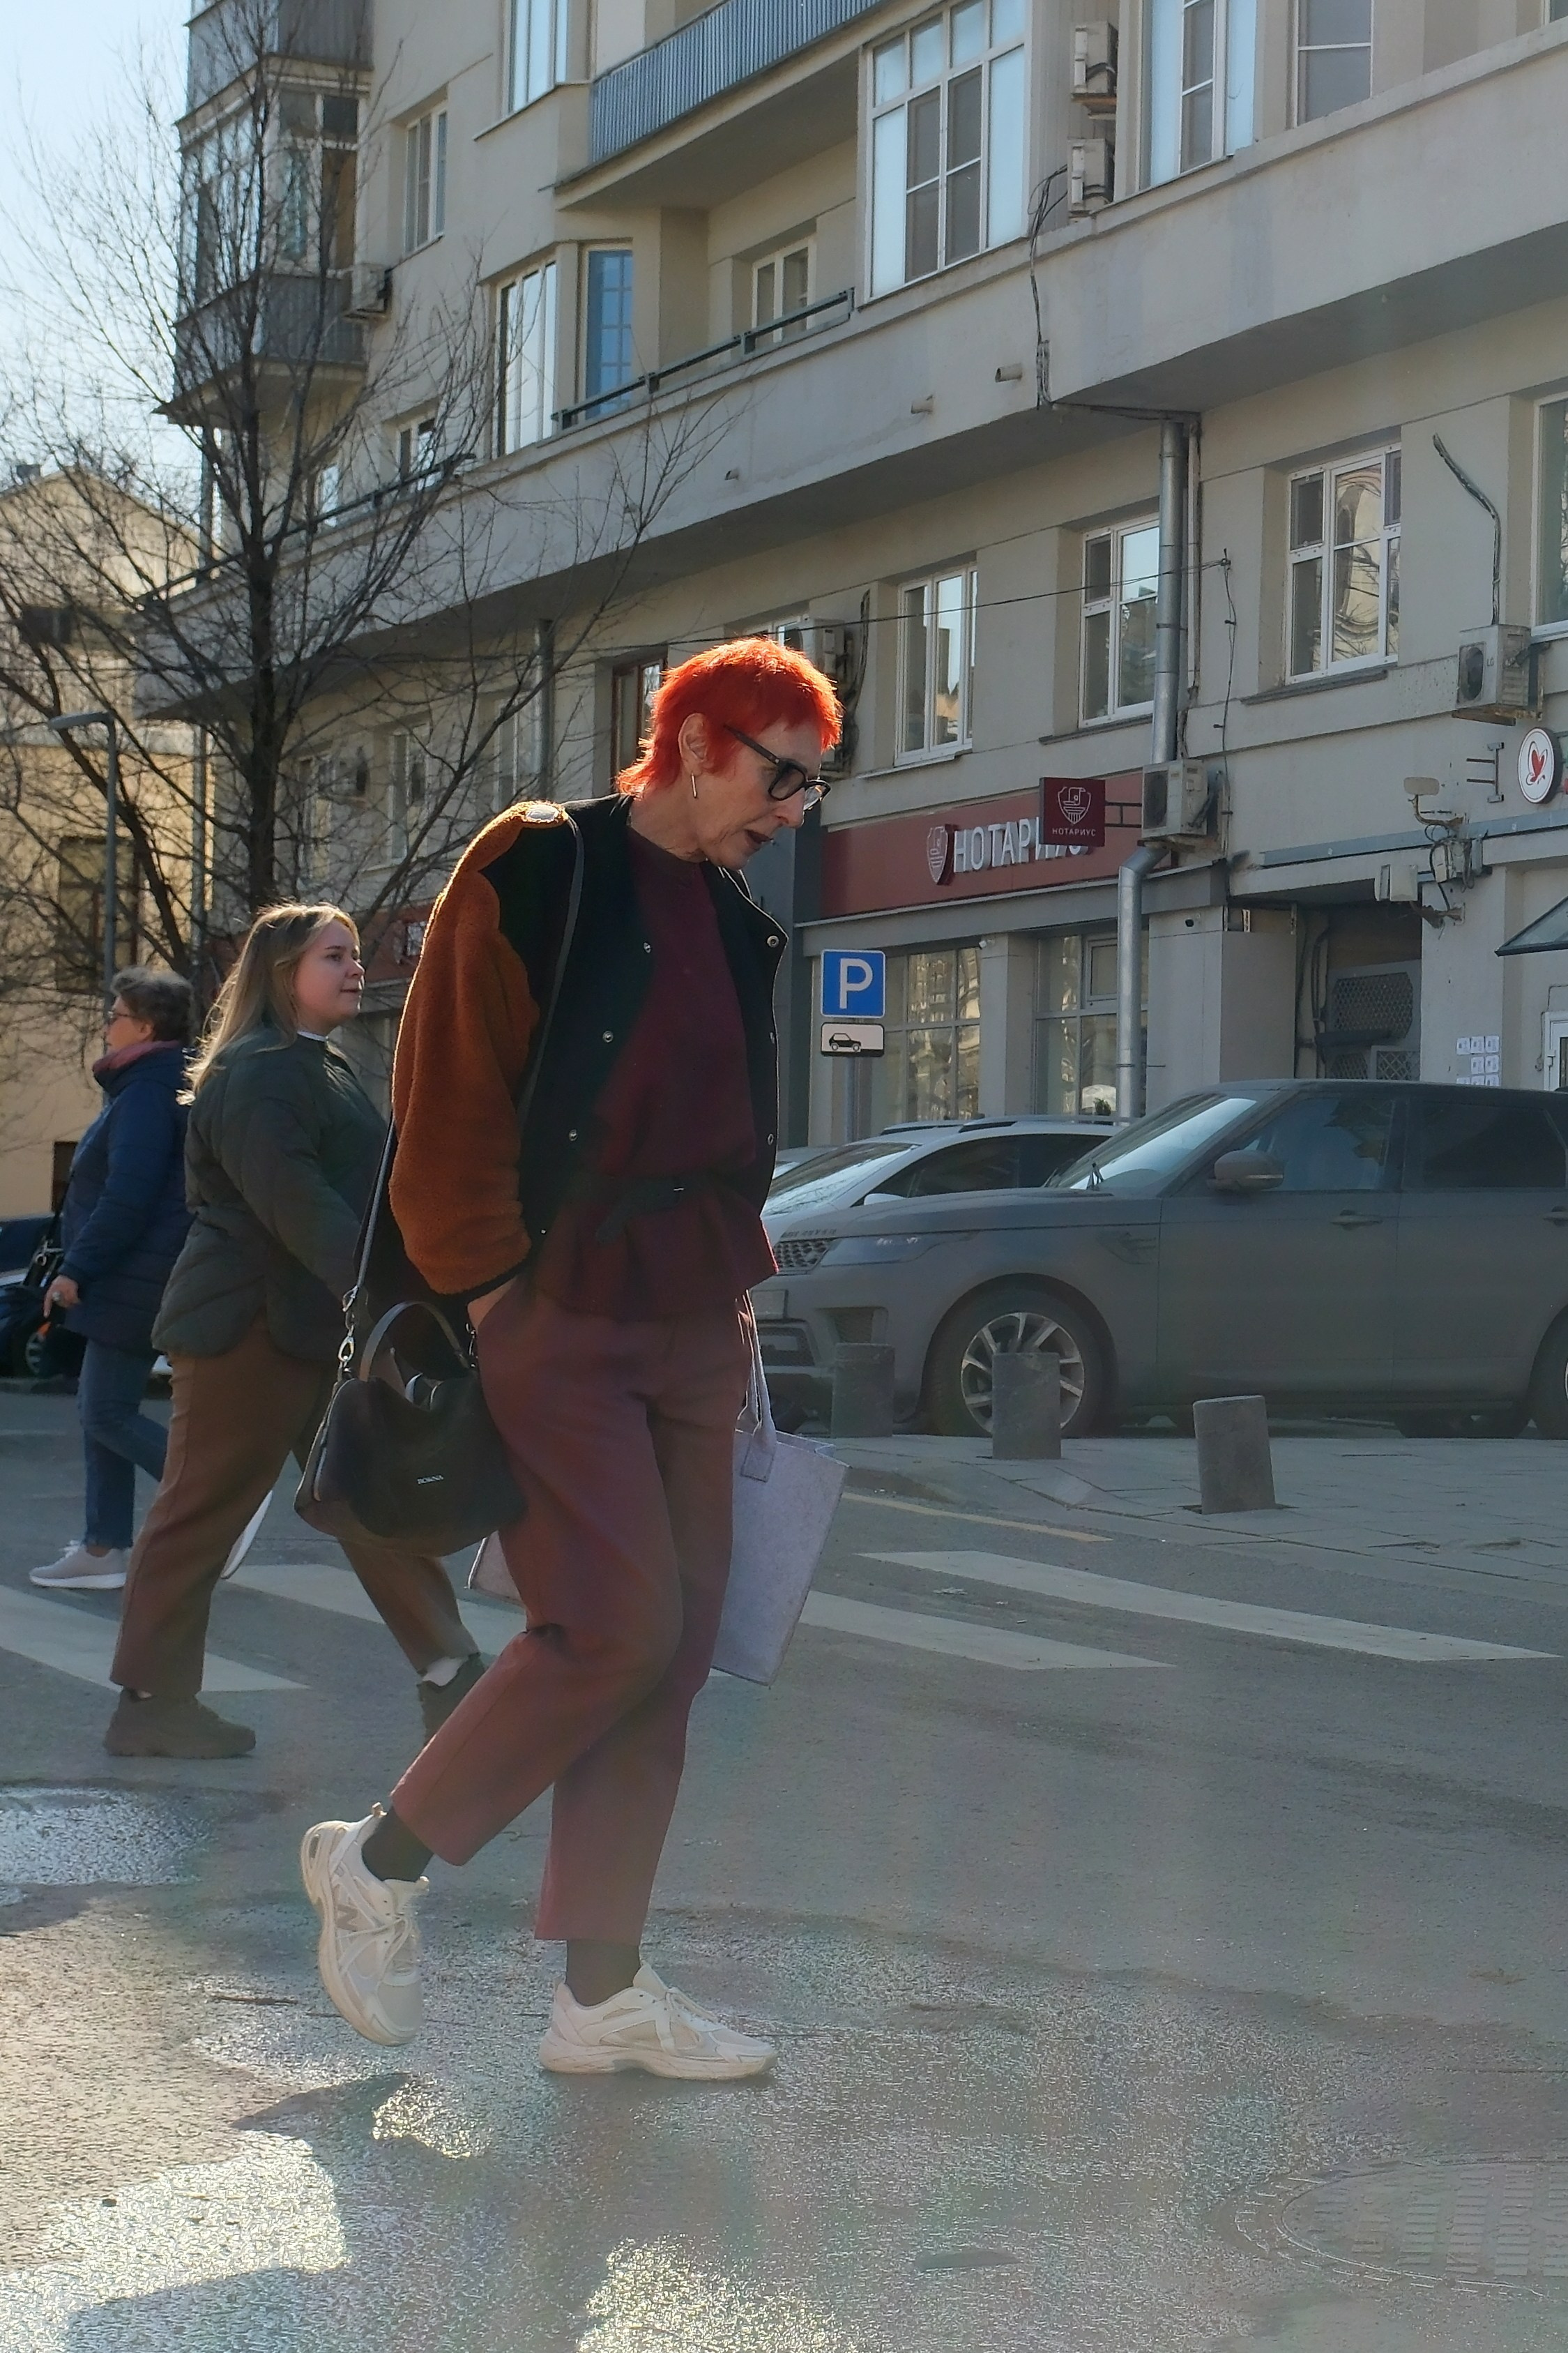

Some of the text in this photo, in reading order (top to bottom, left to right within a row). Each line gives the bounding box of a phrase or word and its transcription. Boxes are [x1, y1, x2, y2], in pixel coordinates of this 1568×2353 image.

[1486, 657, 1494, 667] LG
[1052, 828, 1096, 836] НОТАРИУС
[839, 958, 873, 1009] P
